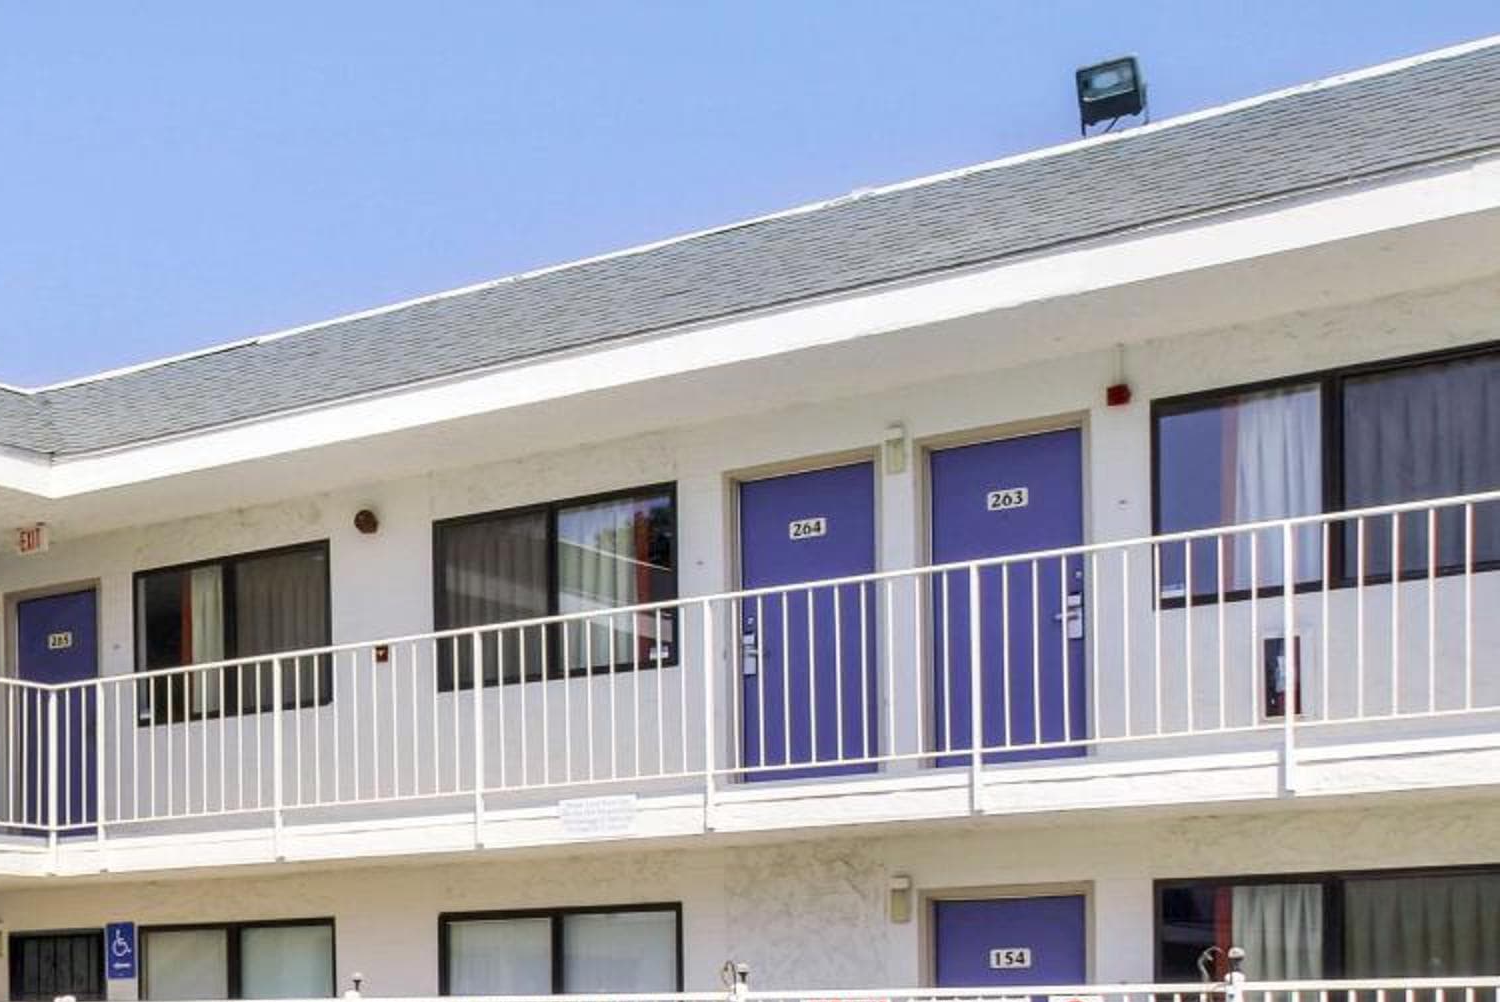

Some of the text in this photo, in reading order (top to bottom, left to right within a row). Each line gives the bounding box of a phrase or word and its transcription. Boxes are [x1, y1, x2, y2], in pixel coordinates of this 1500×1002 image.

[991, 490, 1023, 508] 263
[792, 520, 822, 536] 264
[19, 528, 42, 553] EXIT
[995, 951, 1025, 966] 154
